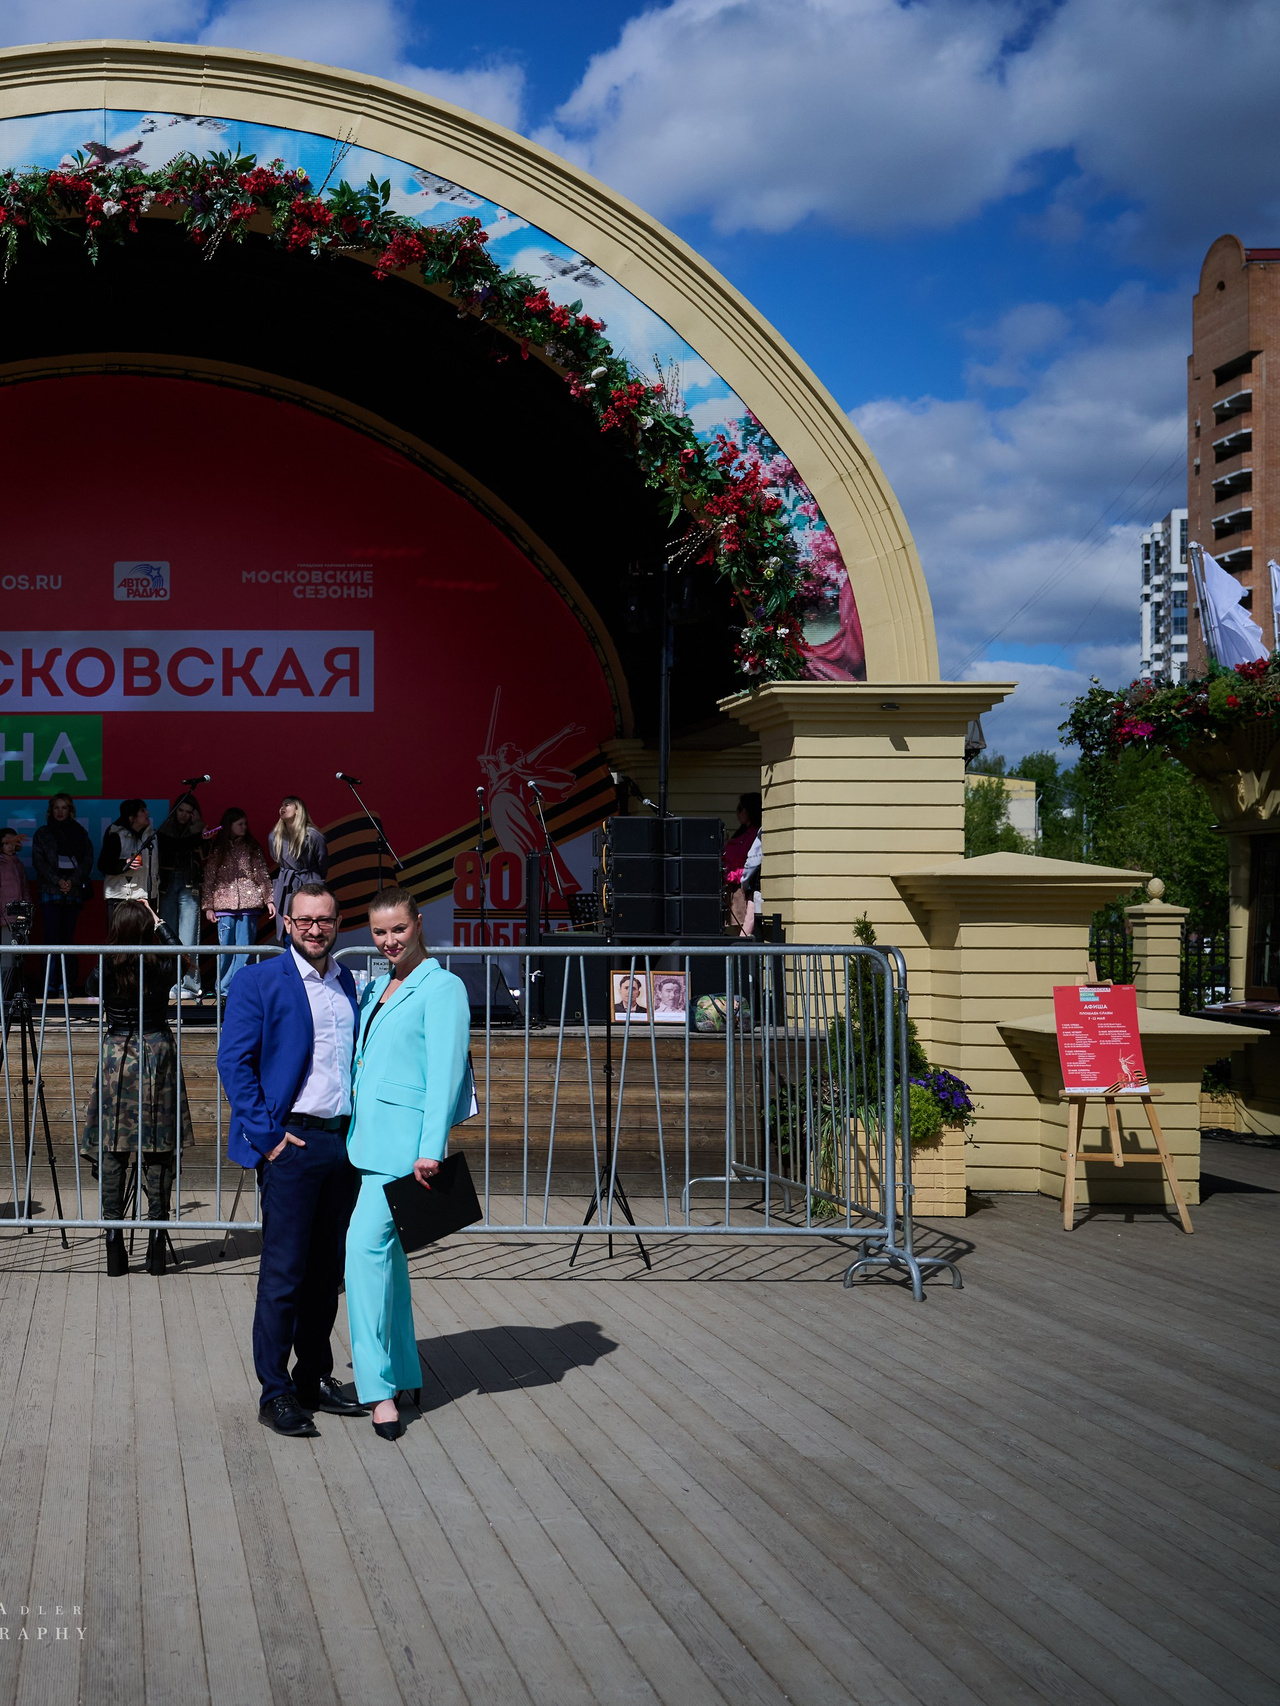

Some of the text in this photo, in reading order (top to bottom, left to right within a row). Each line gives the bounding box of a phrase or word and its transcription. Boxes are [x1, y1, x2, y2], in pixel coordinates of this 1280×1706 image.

[117, 577, 150, 589] АВТО
[241, 570, 373, 583] МОСКОВСКИЕ
[127, 588, 168, 599] РАДИО
[293, 586, 373, 599] СЕЗОНЫ
[453, 851, 523, 909] 80
